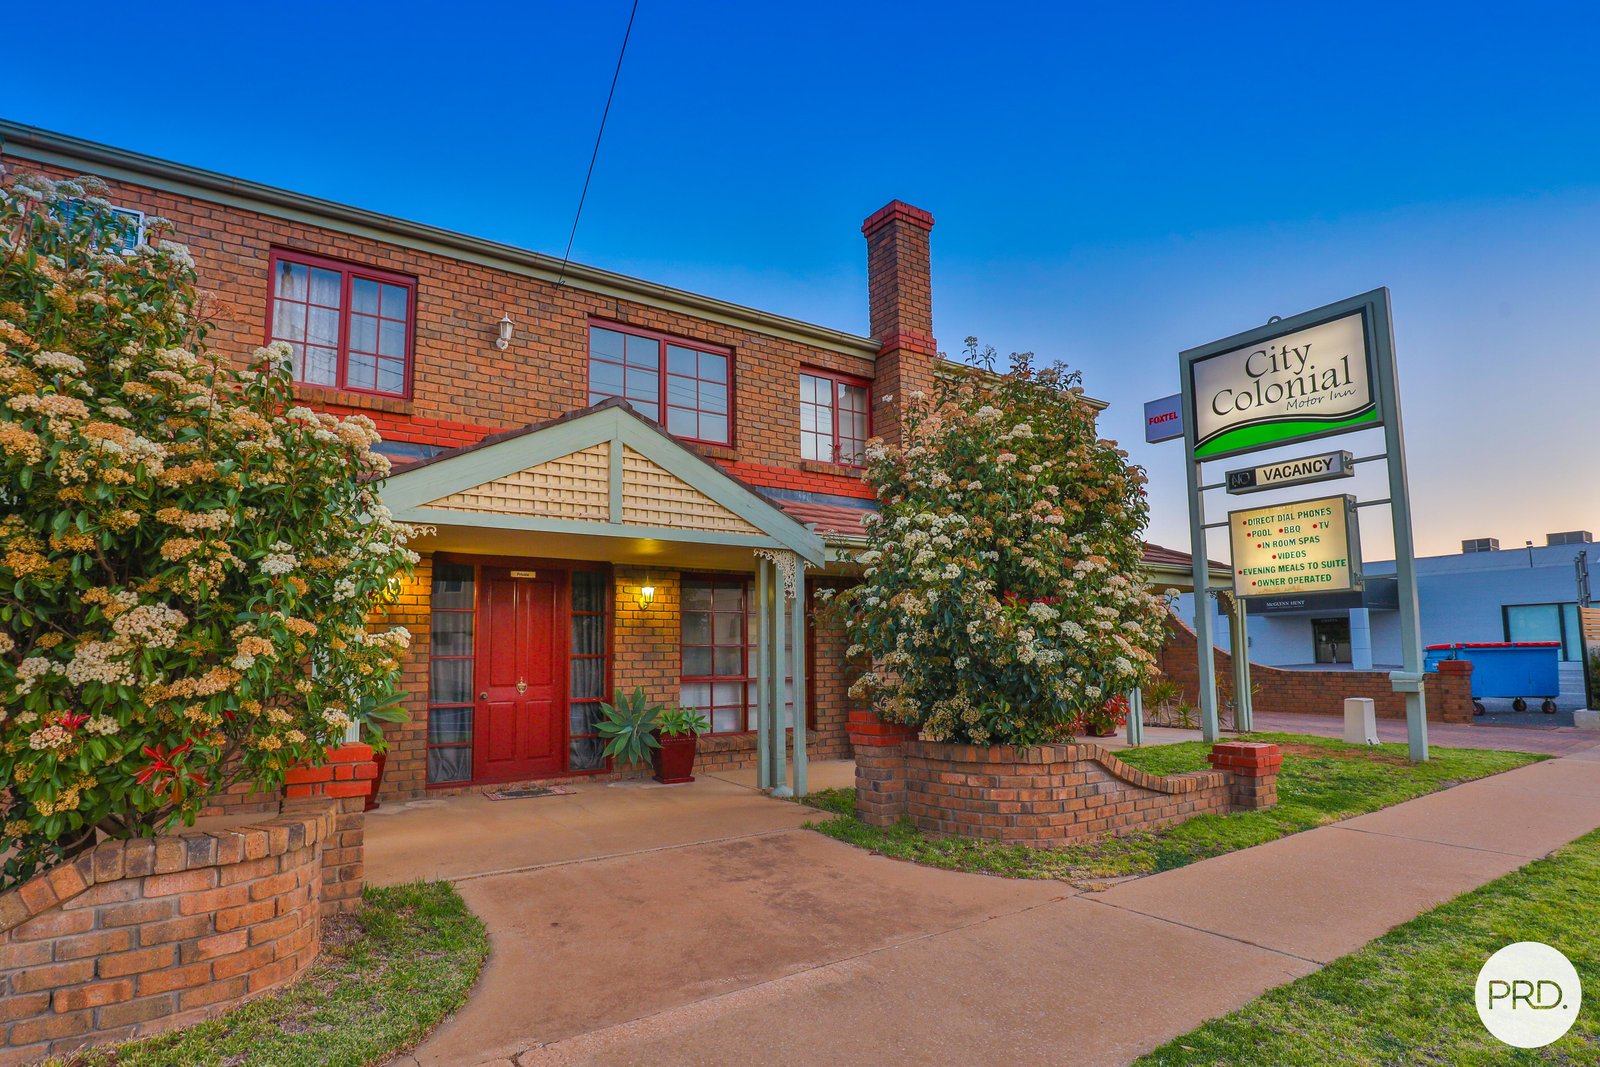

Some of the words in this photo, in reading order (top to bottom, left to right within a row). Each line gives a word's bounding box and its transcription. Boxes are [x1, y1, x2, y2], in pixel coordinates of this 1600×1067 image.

[1245, 343, 1312, 378] City
[1212, 355, 1353, 416] Colonial
[1286, 396, 1325, 411] Motor
[1329, 387, 1356, 401] Inn
[1148, 411, 1178, 426] FOXTEL
[1263, 458, 1333, 481] VACANCY
[1247, 515, 1275, 526] DIRECT
[1277, 513, 1295, 522] DIAL
[1298, 507, 1332, 519] PHONES
[1252, 529, 1272, 538] POOL
[1284, 525, 1301, 534] BBQ
[1319, 521, 1330, 529] TV
[1262, 541, 1270, 549] IN
[1273, 538, 1296, 548] ROOM
[1298, 535, 1320, 545] SPAS
[1277, 550, 1307, 560] VIDEOS
[1243, 566, 1276, 576] EVENING
[1278, 563, 1305, 573] MEALS
[1307, 561, 1319, 570] TO
[1321, 559, 1346, 569] SUITE
[1257, 576, 1286, 588] OWNER
[1288, 573, 1332, 585] OPERATED
